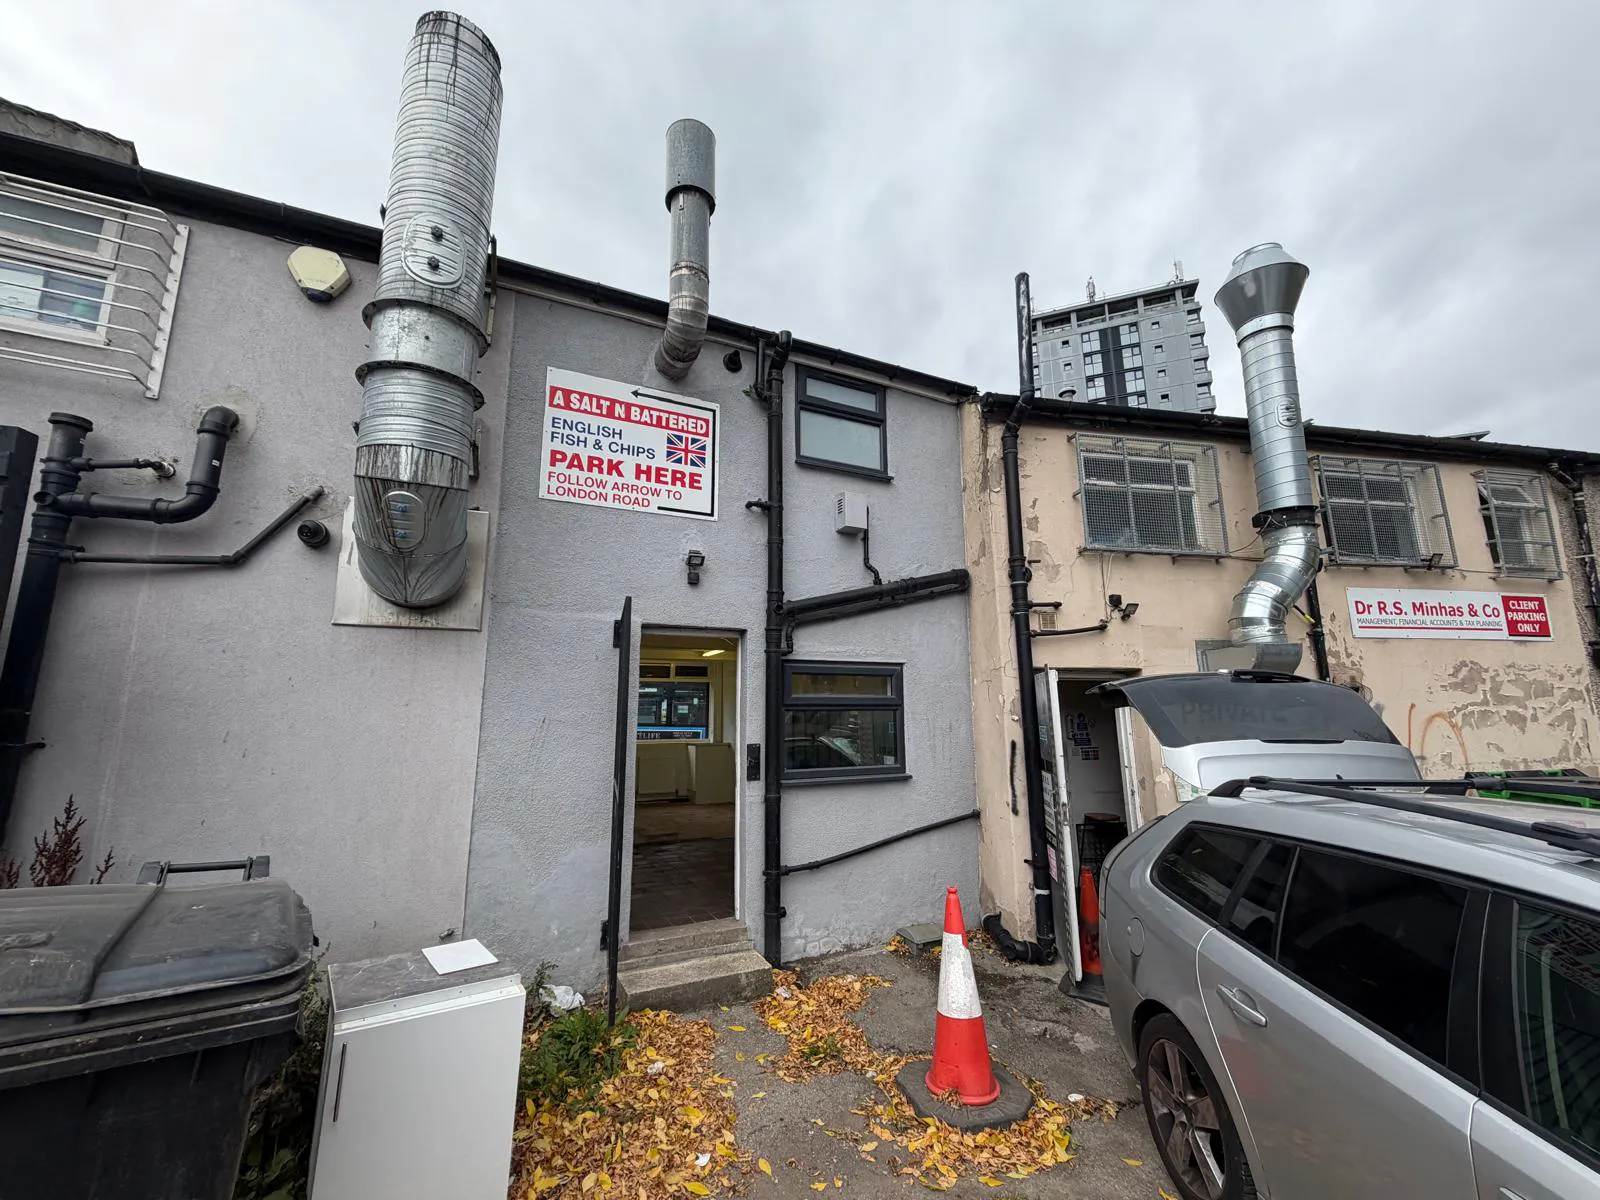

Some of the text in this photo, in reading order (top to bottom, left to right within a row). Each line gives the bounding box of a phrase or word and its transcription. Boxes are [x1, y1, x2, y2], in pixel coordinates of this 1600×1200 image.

[553, 390, 707, 434] A SALT N BATTERED
[551, 417, 623, 440] ENGLISH
[550, 432, 656, 460] FISH & CHIPS
[549, 449, 703, 490] PARK HERE
[547, 484, 650, 508] LONDON ROAD
[548, 471, 682, 501] FOLLOW ARROW TO
[1354, 600, 1501, 618] Dr R.S. Minhas & Co
[1509, 600, 1539, 610] CLIENT
[1356, 618, 1398, 626] MANAGEMENT,
[1399, 618, 1428, 626] FINANCIAL
[1429, 619, 1458, 627] ACCOUNTS
[1507, 612, 1546, 622] PARKING
[1517, 623, 1540, 633] ONLY
[1182, 701, 1287, 725] PRIVATE
